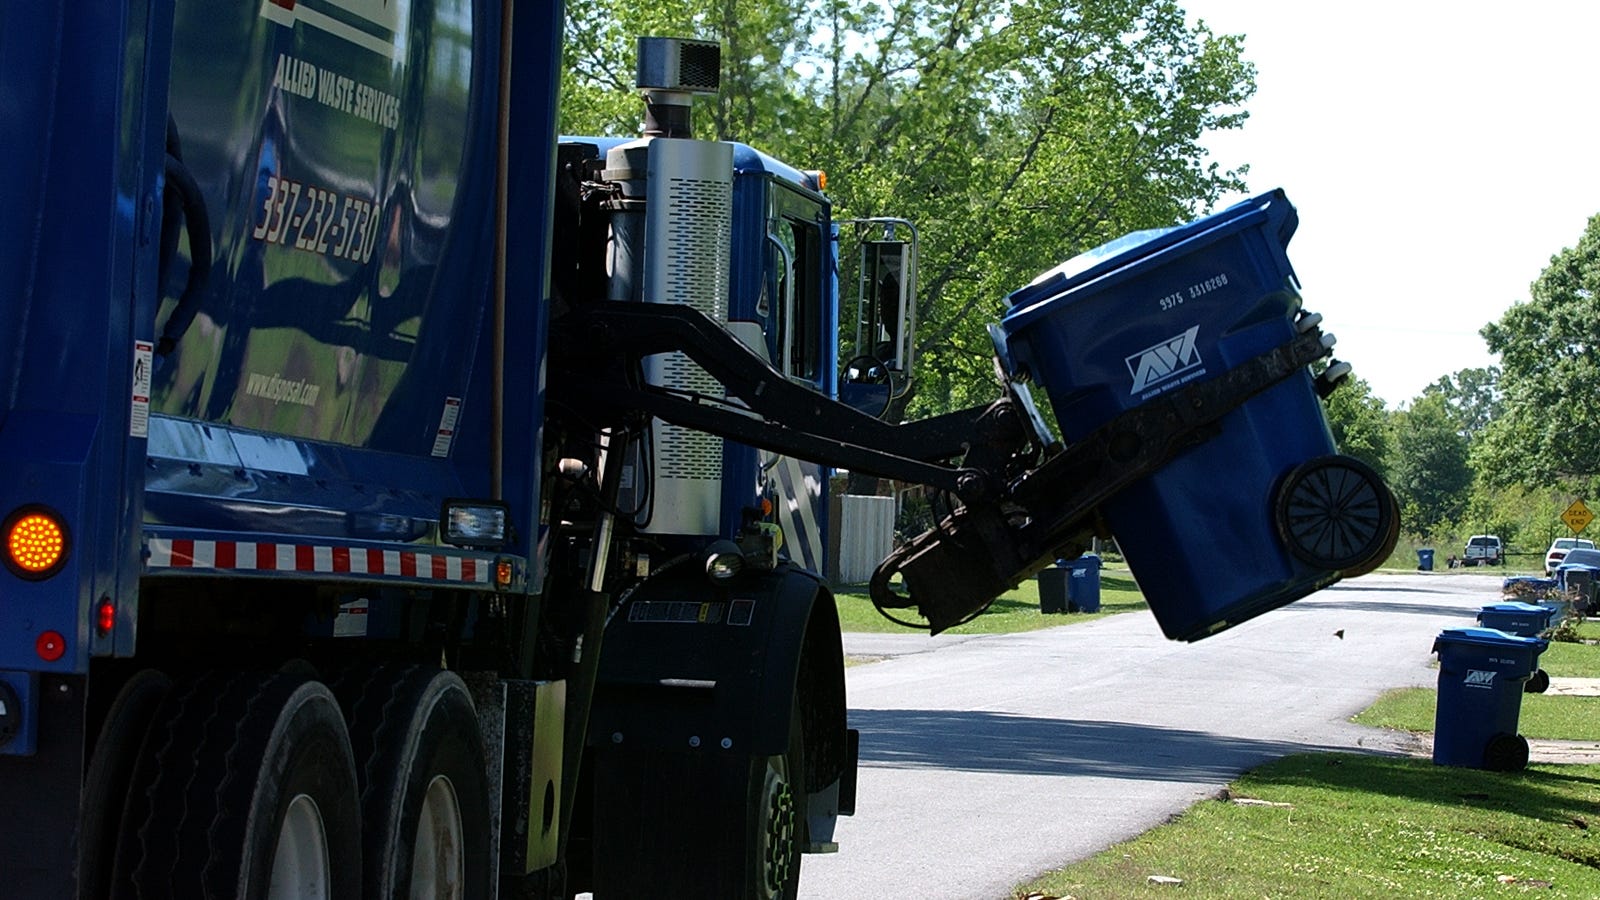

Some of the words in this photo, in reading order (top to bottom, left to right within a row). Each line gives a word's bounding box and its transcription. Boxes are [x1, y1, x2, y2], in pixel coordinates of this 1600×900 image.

[273, 53, 317, 99] ALLIED
[318, 68, 355, 113] WASTE
[354, 83, 400, 130] SERVICES
[253, 176, 380, 264] 337-232-5730
[1160, 292, 1183, 311] 9975
[246, 372, 320, 406] www.disposal.com
